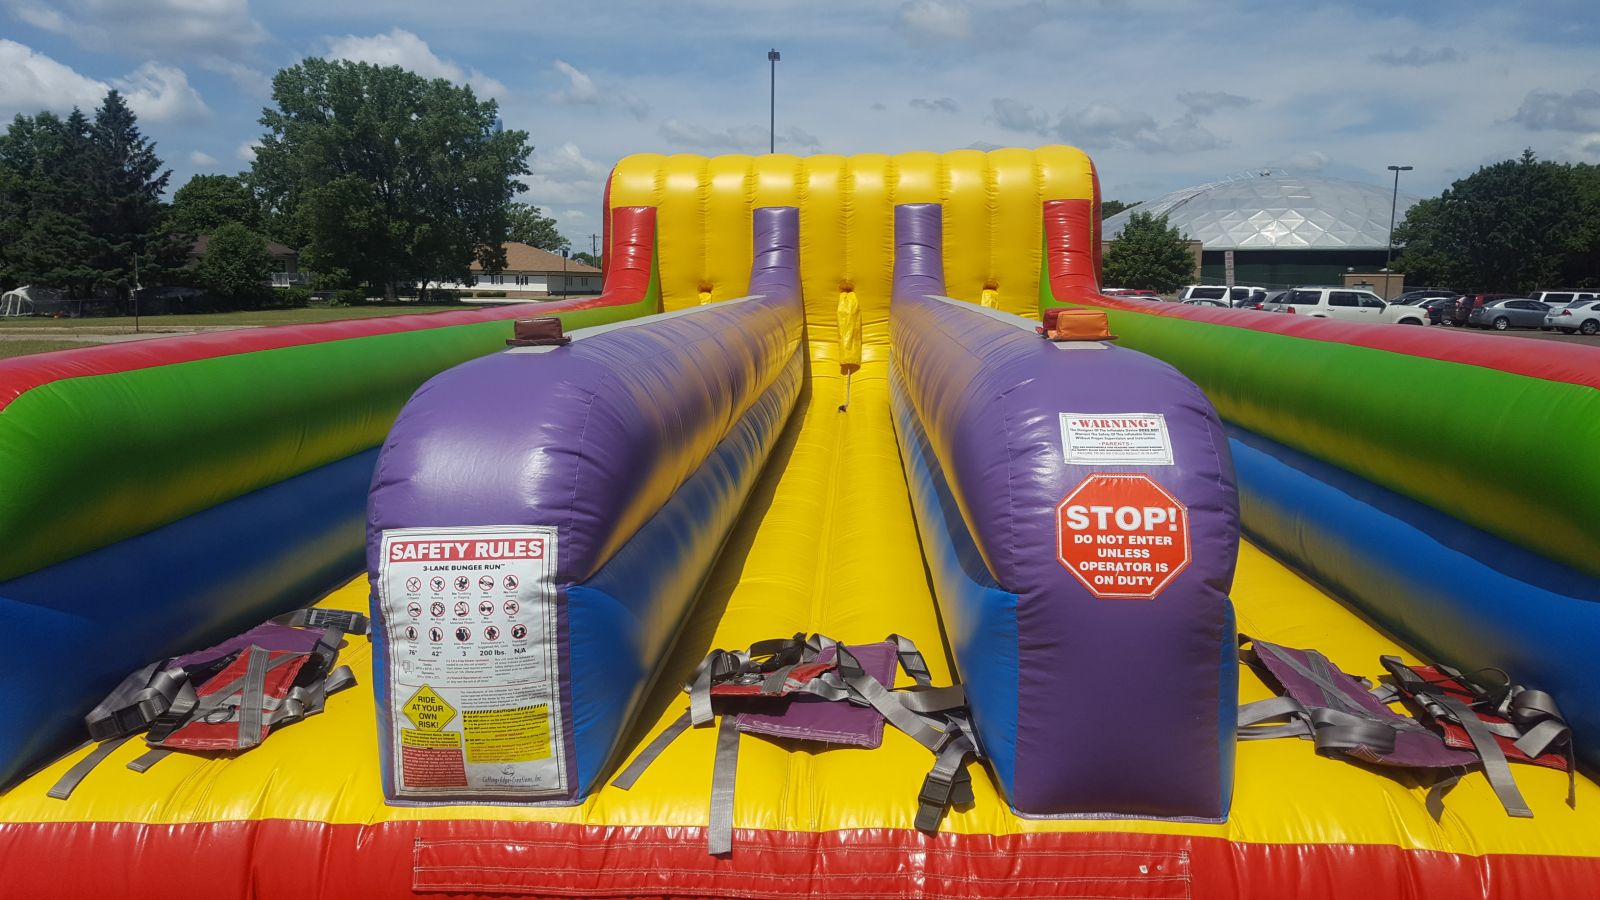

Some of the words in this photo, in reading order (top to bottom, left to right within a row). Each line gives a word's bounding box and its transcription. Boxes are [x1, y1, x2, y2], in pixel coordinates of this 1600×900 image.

[1079, 419, 1148, 428] WARNING
[1066, 505, 1178, 532] STOP!
[1074, 534, 1093, 544] DO
[1096, 535, 1125, 545] NOT
[1128, 535, 1173, 546] ENTER
[391, 542, 470, 560] SAFETY
[475, 541, 542, 558] RULES
[1097, 548, 1150, 558] UNLESS
[1079, 561, 1152, 572] OPERATOR
[1155, 563, 1169, 573] IS
[1094, 575, 1114, 585] ON
[1117, 576, 1155, 586] DUTY
